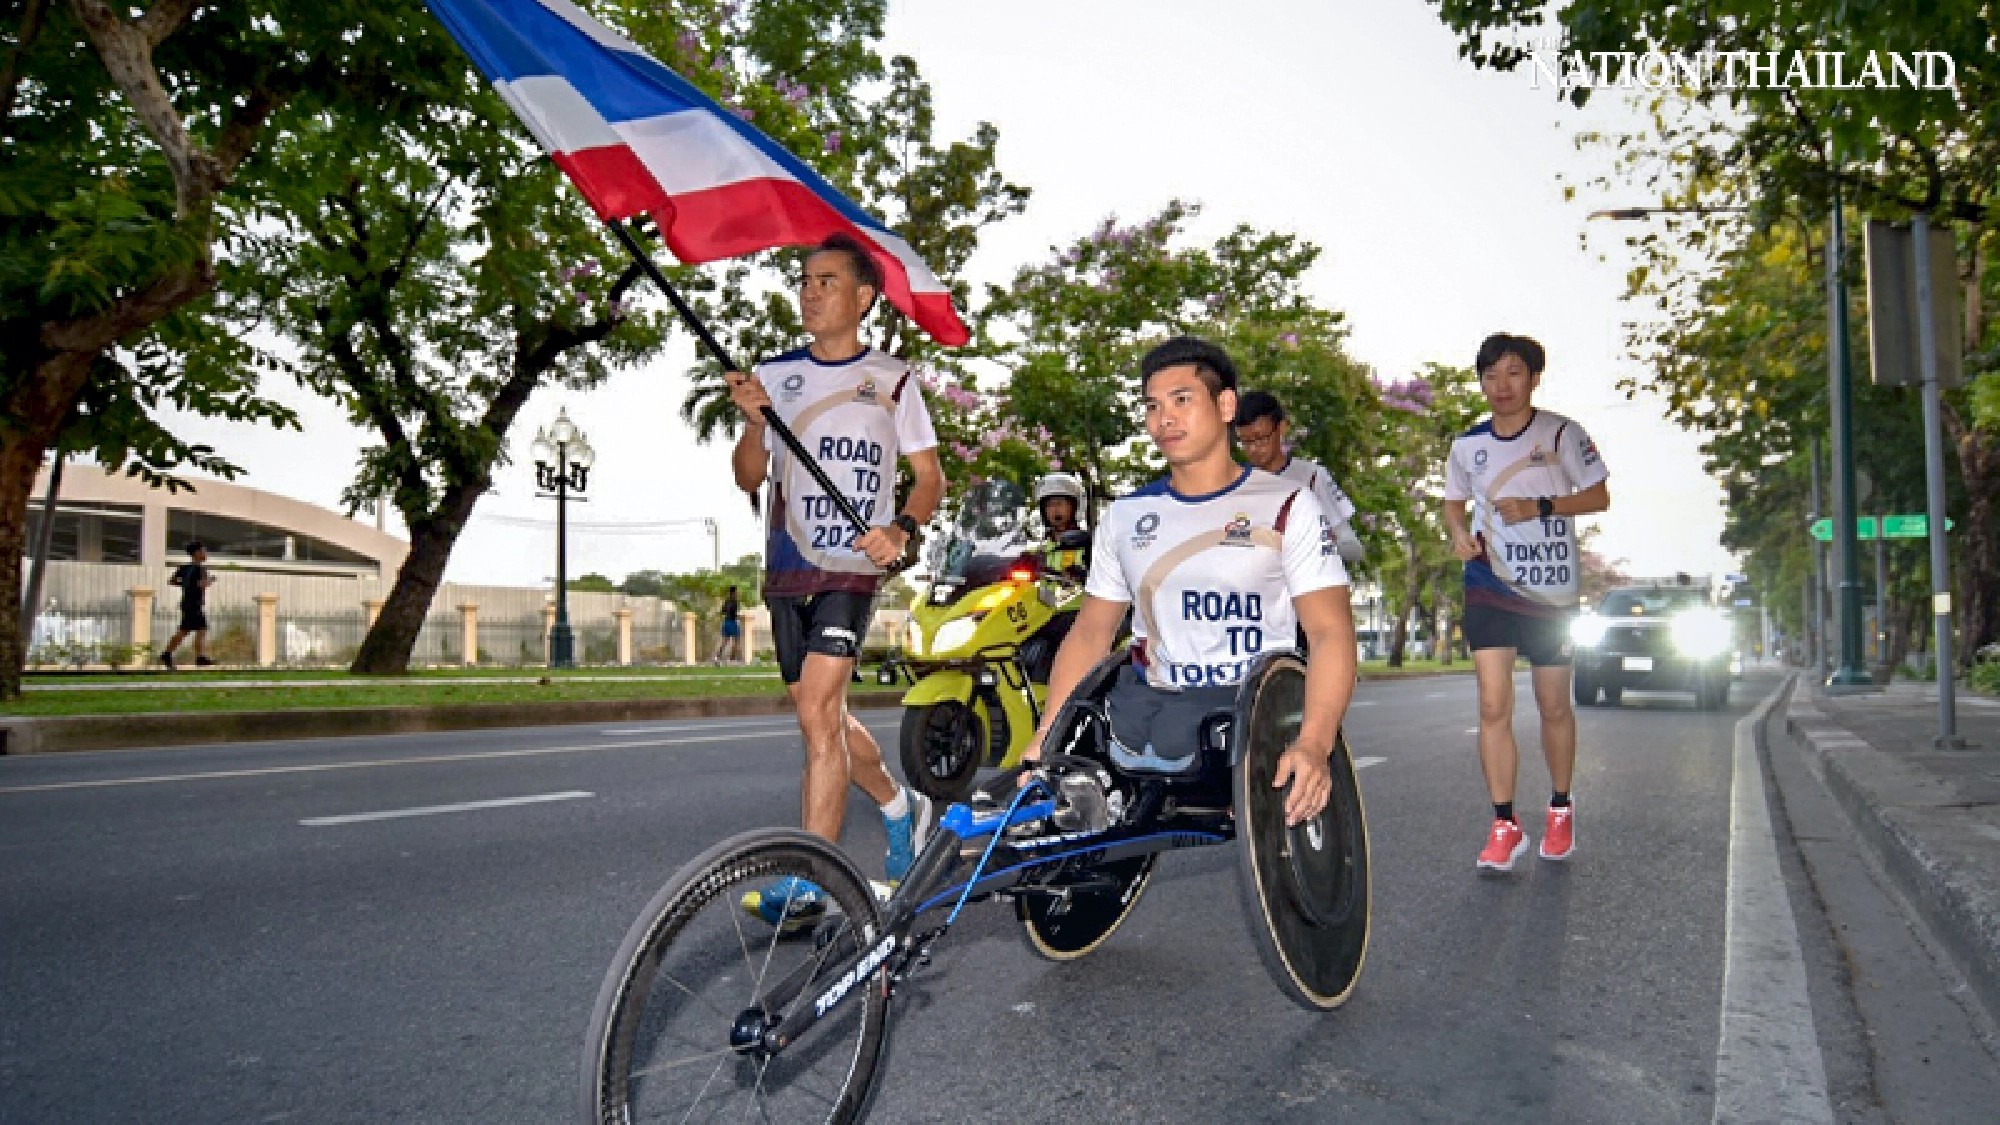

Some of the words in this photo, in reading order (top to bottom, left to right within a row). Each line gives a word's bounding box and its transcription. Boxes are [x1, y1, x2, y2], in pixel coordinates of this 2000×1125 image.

[819, 437, 882, 466] ROAD
[852, 467, 881, 493] TO
[812, 524, 860, 550] 202
[1540, 519, 1567, 538] TO
[1505, 541, 1569, 563] TOKYO
[1515, 564, 1571, 586] 2020
[1182, 590, 1262, 621] ROAD
[1226, 626, 1262, 655] TO
[1169, 658, 1254, 686] TOKY
